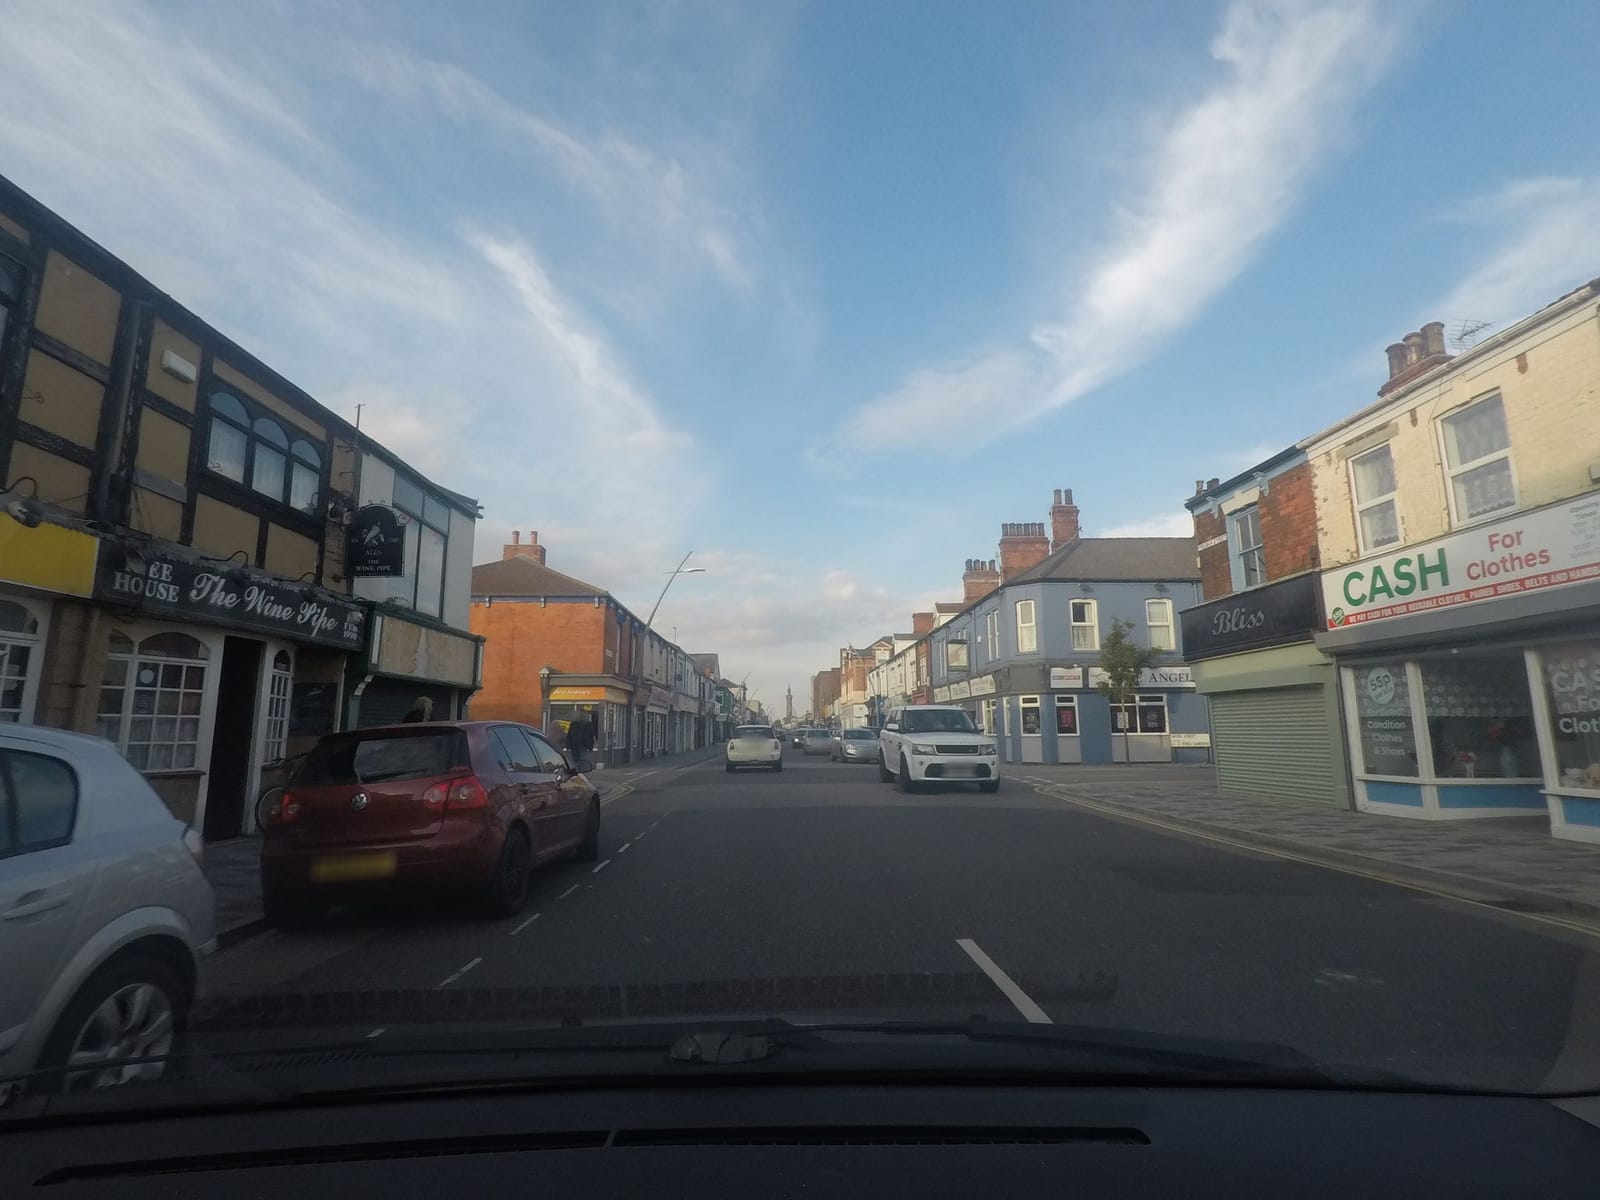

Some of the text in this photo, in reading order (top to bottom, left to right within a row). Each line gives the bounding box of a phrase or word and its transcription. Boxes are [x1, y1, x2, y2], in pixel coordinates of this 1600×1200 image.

[1487, 529, 1524, 553] For
[149, 561, 174, 582] EE
[1466, 548, 1551, 581] Clothes
[112, 571, 180, 603] HOUSE
[1343, 547, 1450, 607] CASH
[1551, 573, 1568, 584] AND
[189, 573, 338, 637] The Wine Pipe
[1212, 607, 1265, 636] Bliss
[1149, 671, 1195, 684] ANGEL
[1367, 720, 1406, 729] Condition
[1559, 717, 1600, 734] Clot
[1372, 732, 1403, 742] Clothes
